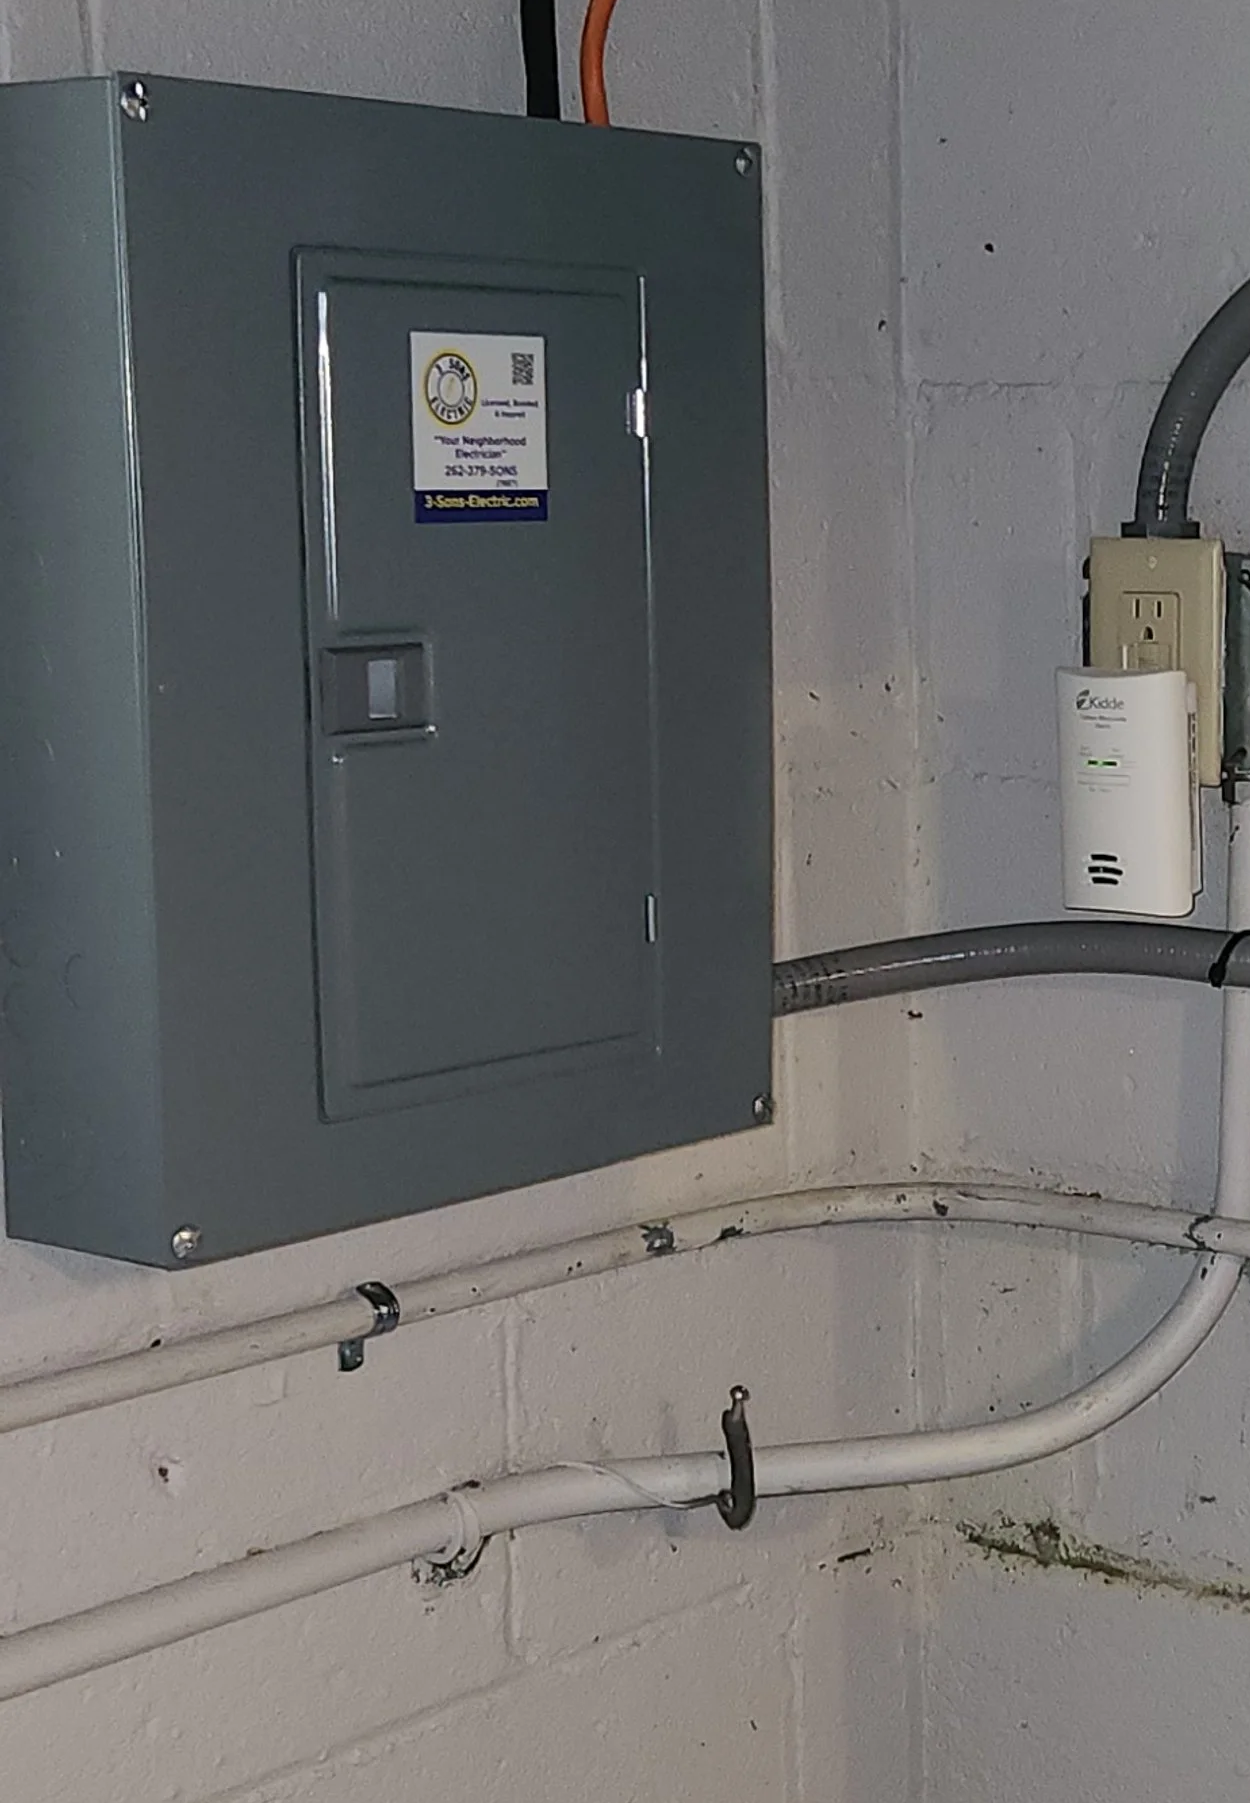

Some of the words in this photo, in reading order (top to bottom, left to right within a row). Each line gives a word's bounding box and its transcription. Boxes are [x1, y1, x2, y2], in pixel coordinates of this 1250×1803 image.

[428, 396, 473, 420] ELECTRIC
[461, 435, 526, 447] Neighborhood
[444, 464, 518, 476] 262-379-SONS
[423, 493, 540, 509] 3-Sons-Electric.com
[1089, 695, 1125, 710] Kidde
